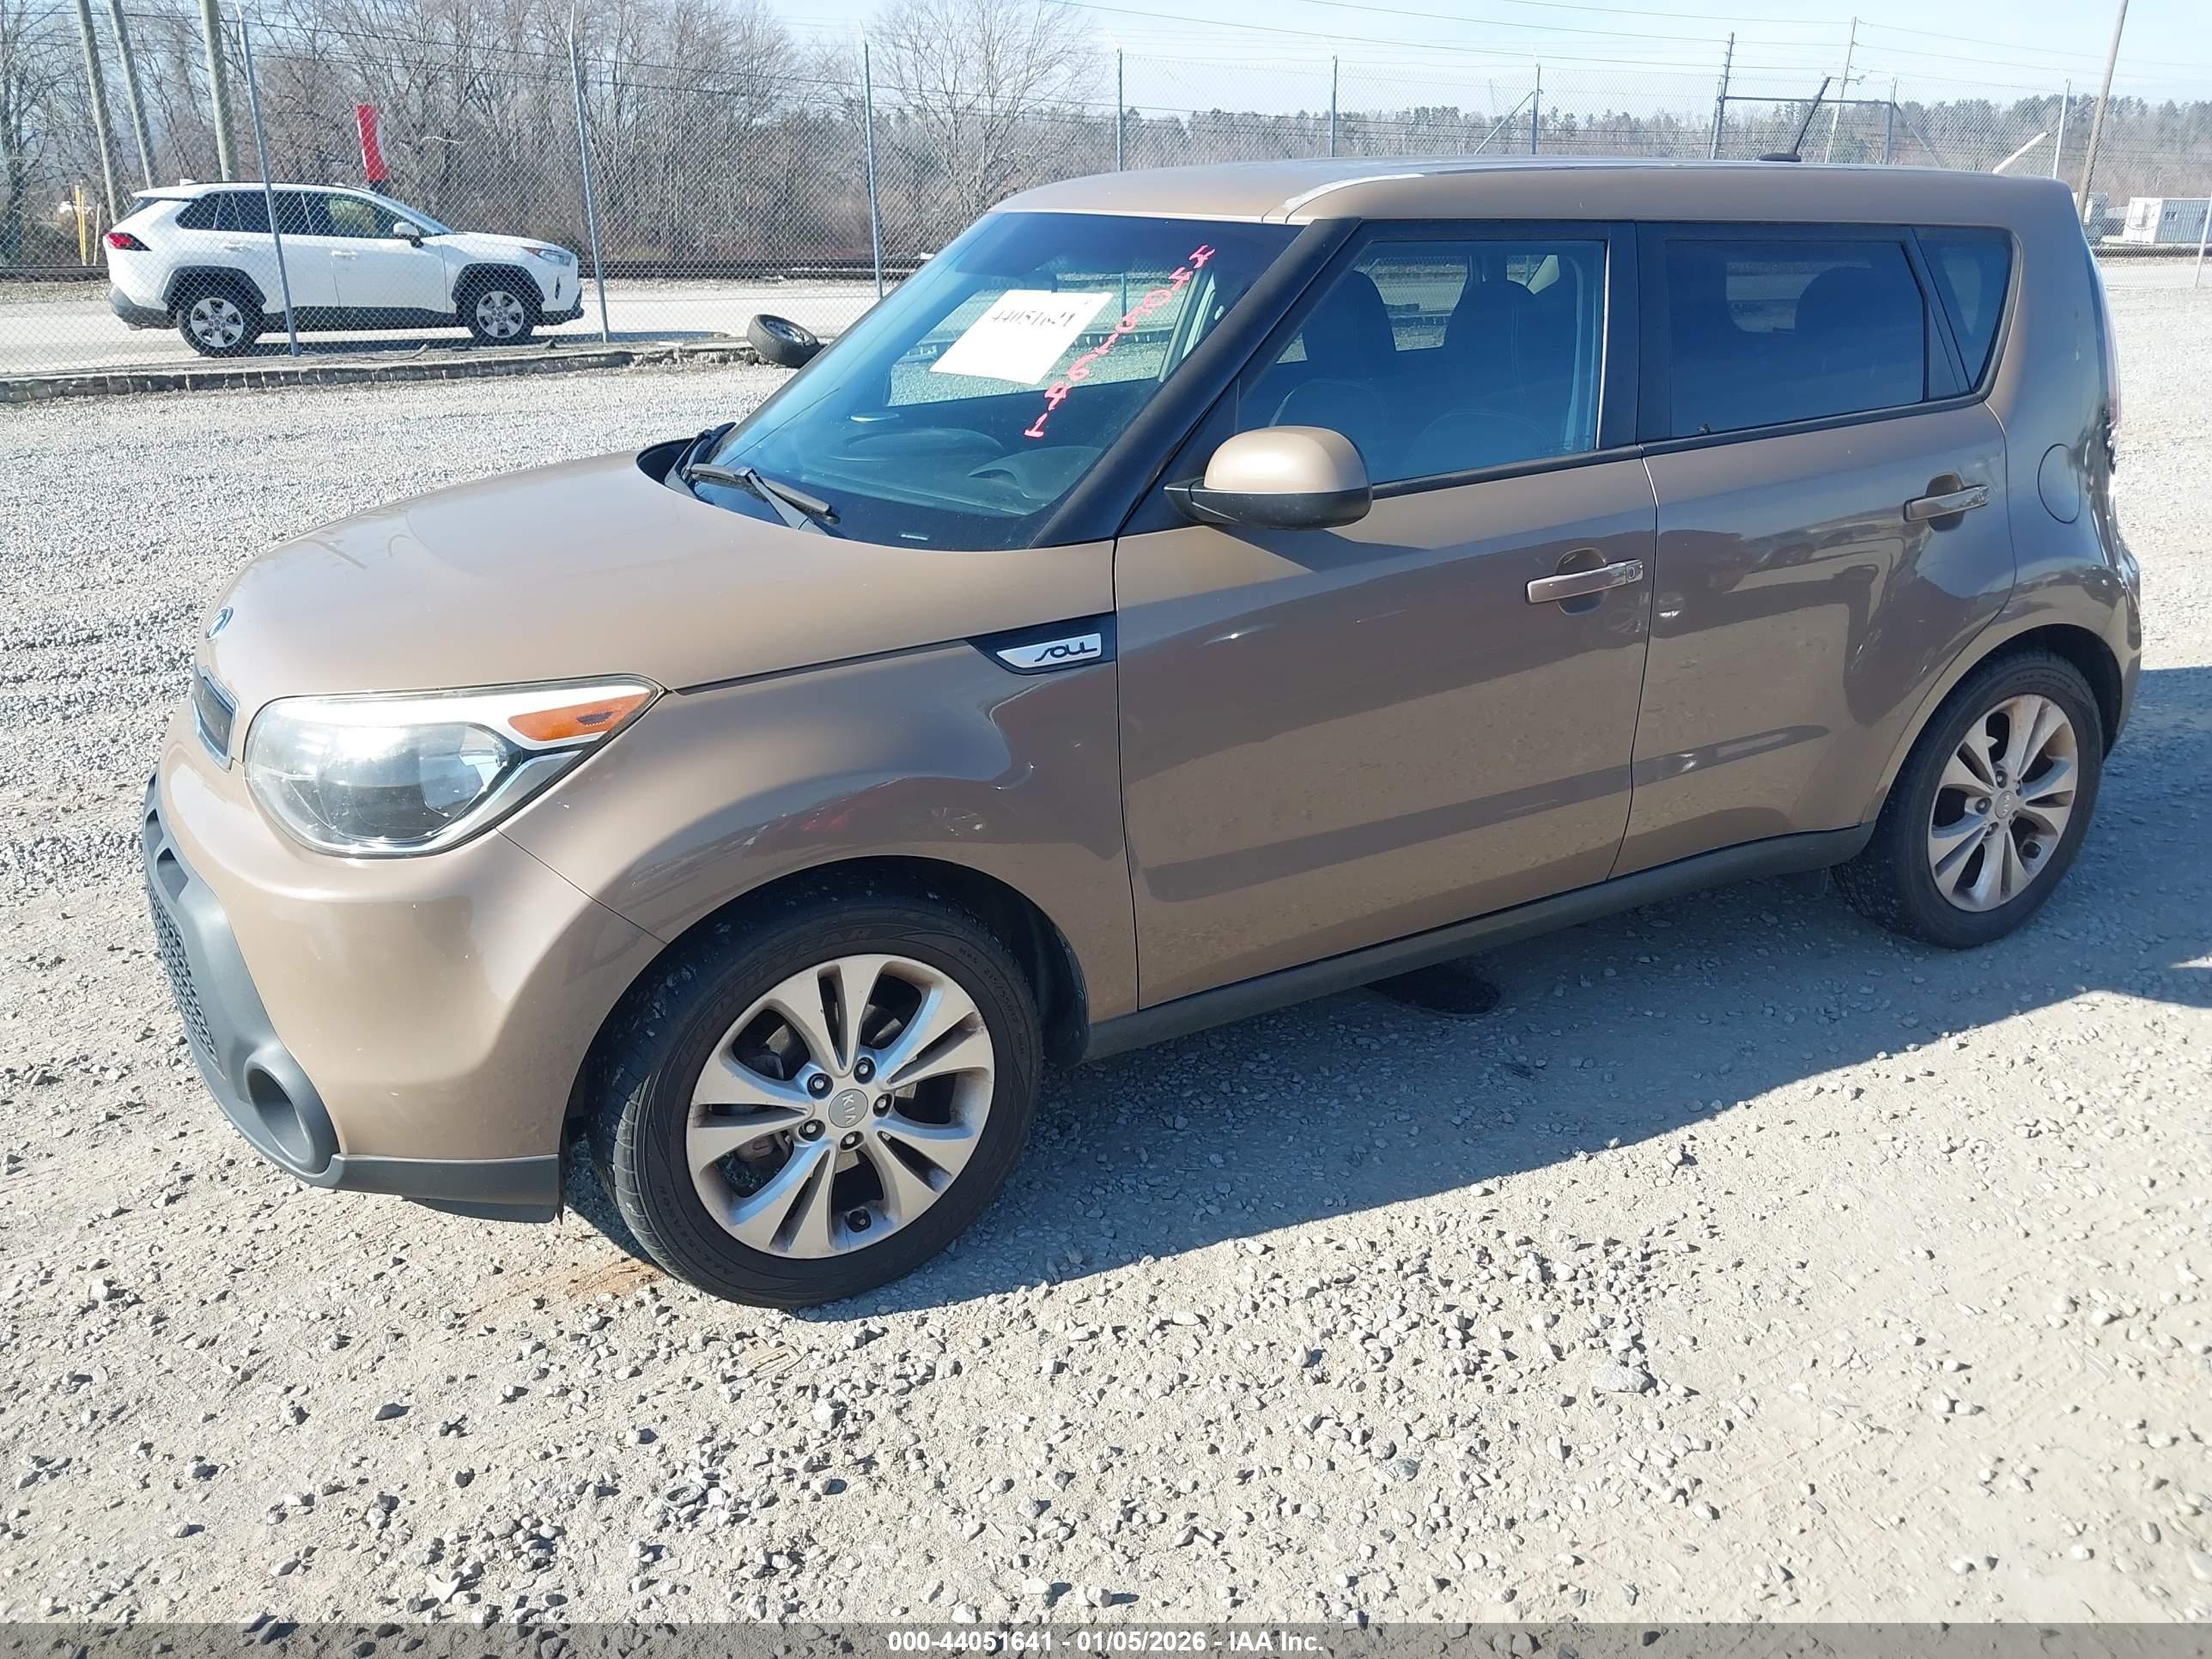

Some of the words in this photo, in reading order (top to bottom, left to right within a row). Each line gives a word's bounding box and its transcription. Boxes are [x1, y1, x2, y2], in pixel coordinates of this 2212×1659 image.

[1024, 245, 1215, 438] 44051641
[1034, 641, 1097, 662] SOUL
[841, 1092, 857, 1126] KIA
